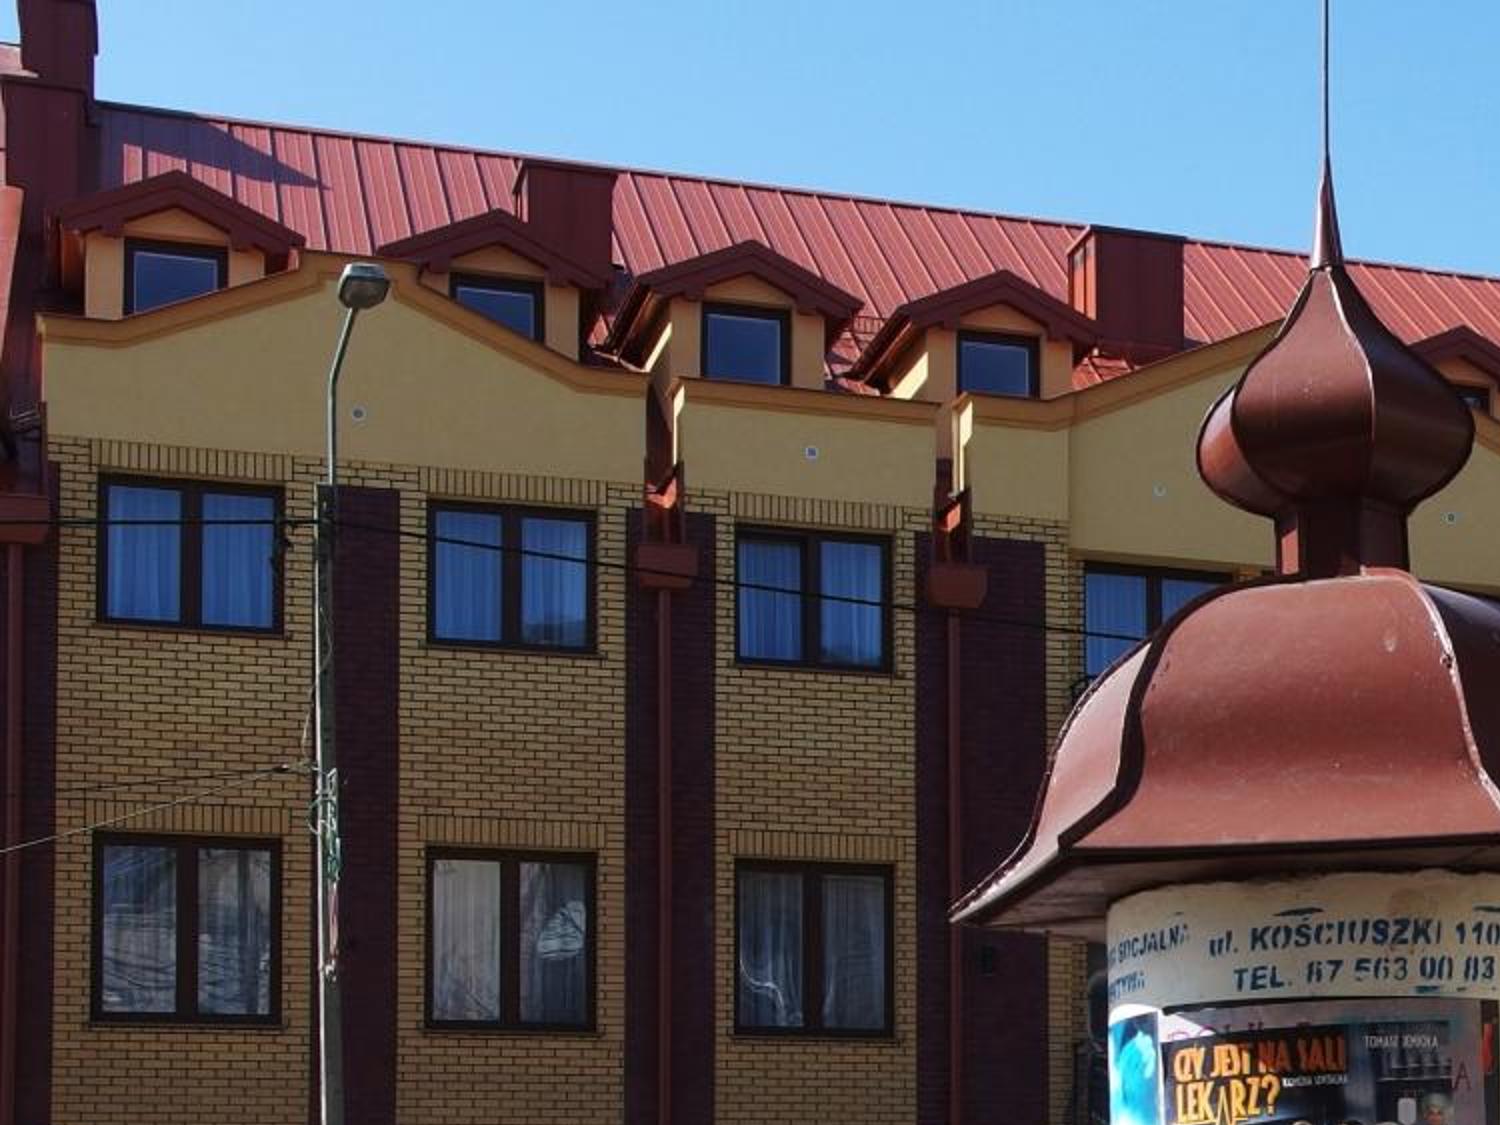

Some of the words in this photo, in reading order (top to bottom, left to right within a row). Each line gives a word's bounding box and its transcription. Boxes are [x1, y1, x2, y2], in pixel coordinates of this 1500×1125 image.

[1209, 929, 1239, 957] ul.
[1250, 915, 1442, 952] KOŚCIUSZKI
[1233, 964, 1293, 992] TEL.
[1257, 1039, 1293, 1073] NA
